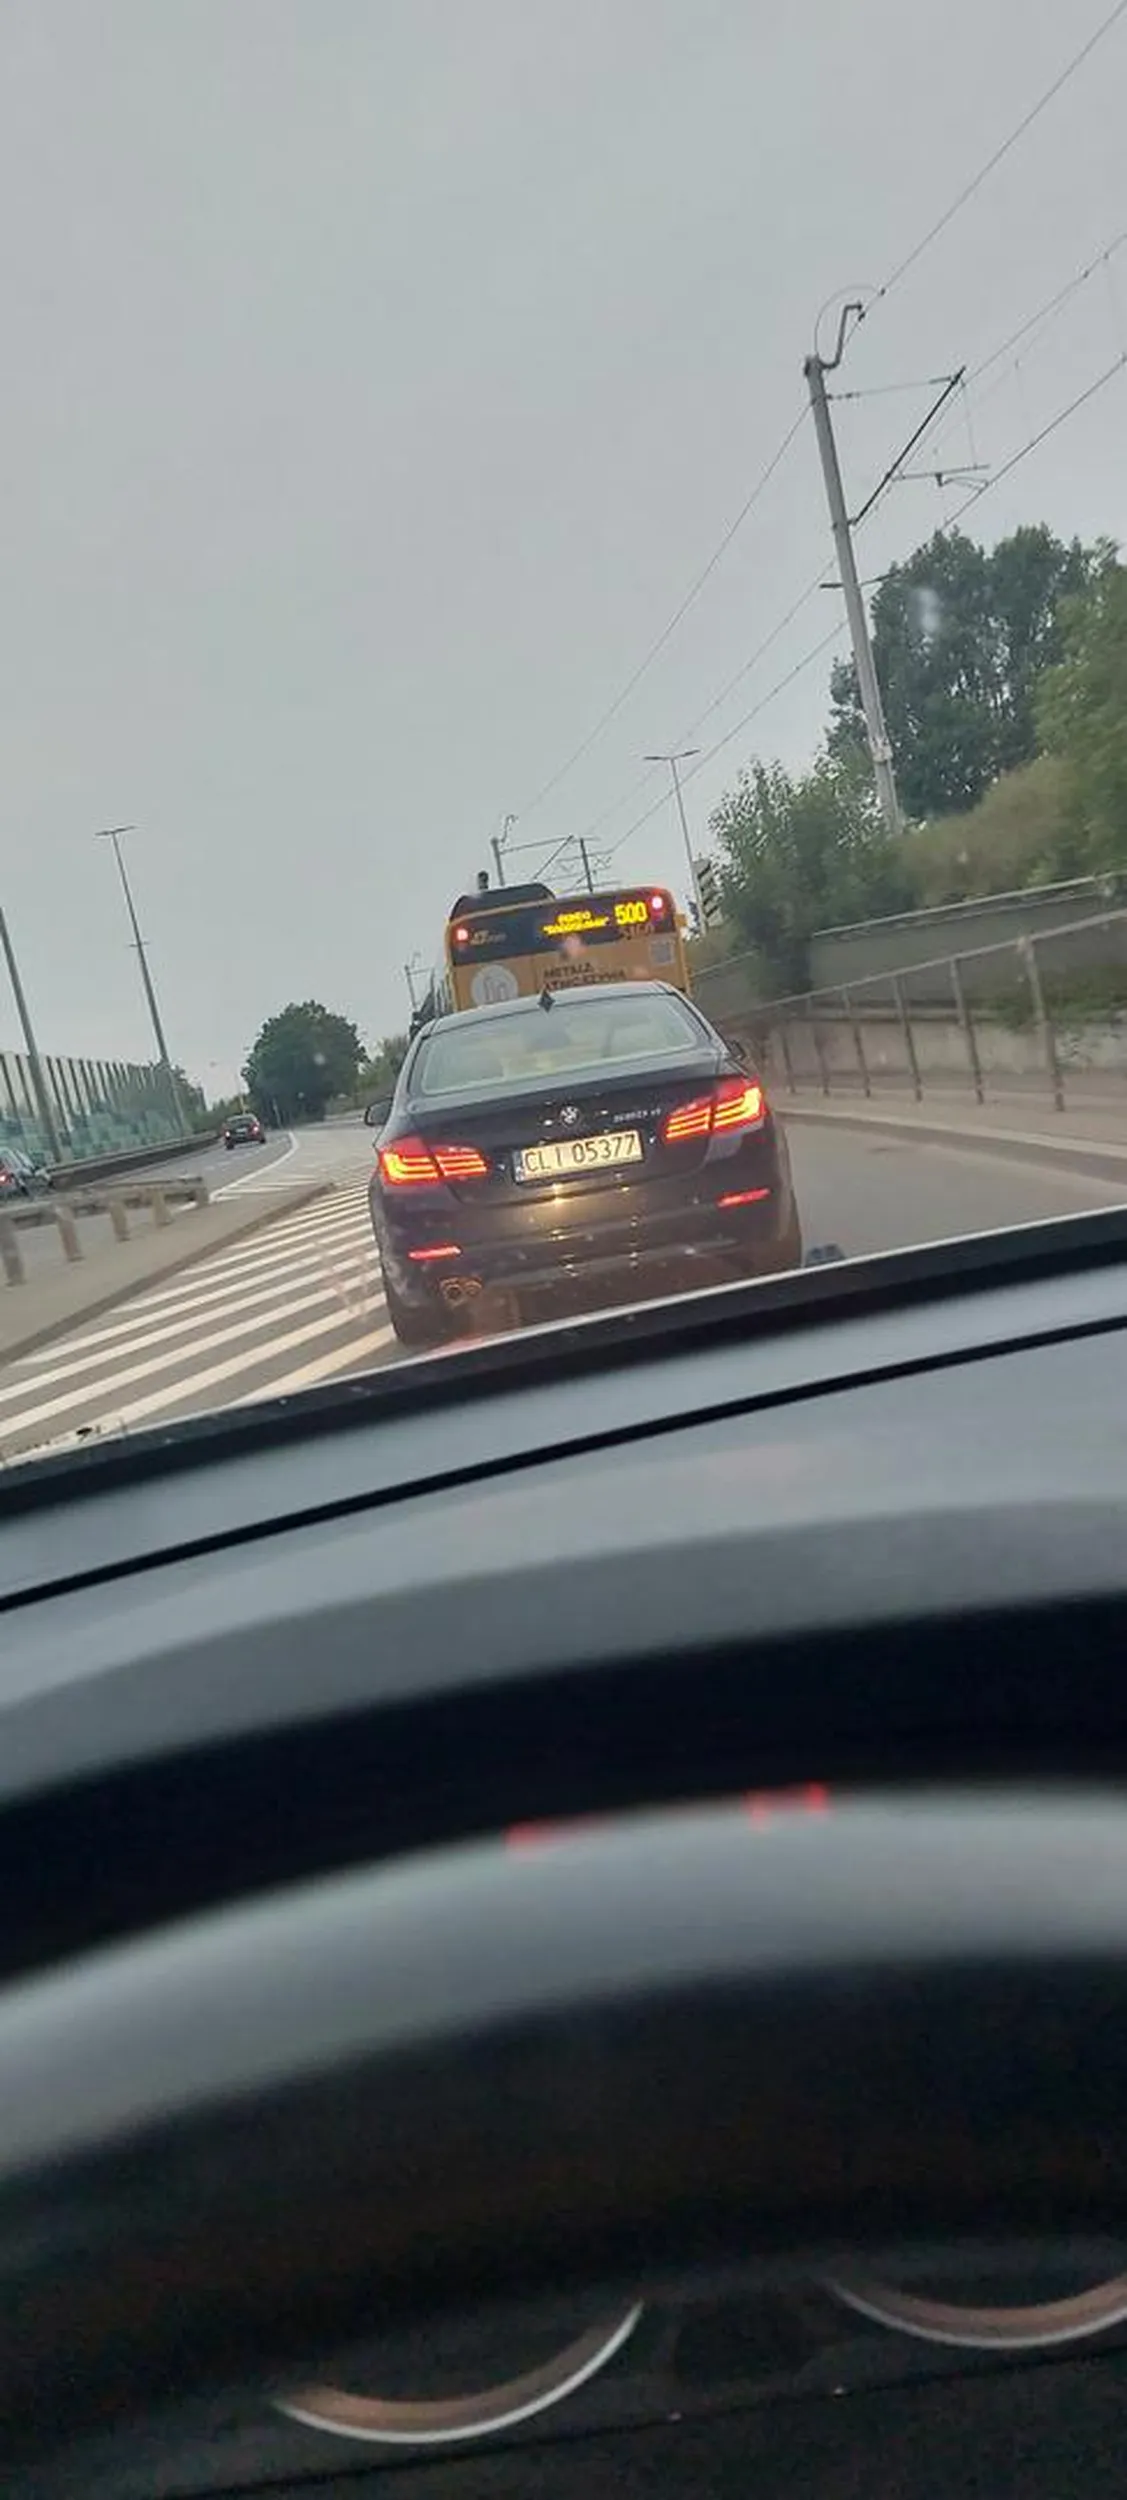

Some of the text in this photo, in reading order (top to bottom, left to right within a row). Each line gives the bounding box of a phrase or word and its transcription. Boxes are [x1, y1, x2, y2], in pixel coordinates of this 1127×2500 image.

[615, 901, 648, 925] 500
[525, 1134, 635, 1172] CLI 05377
